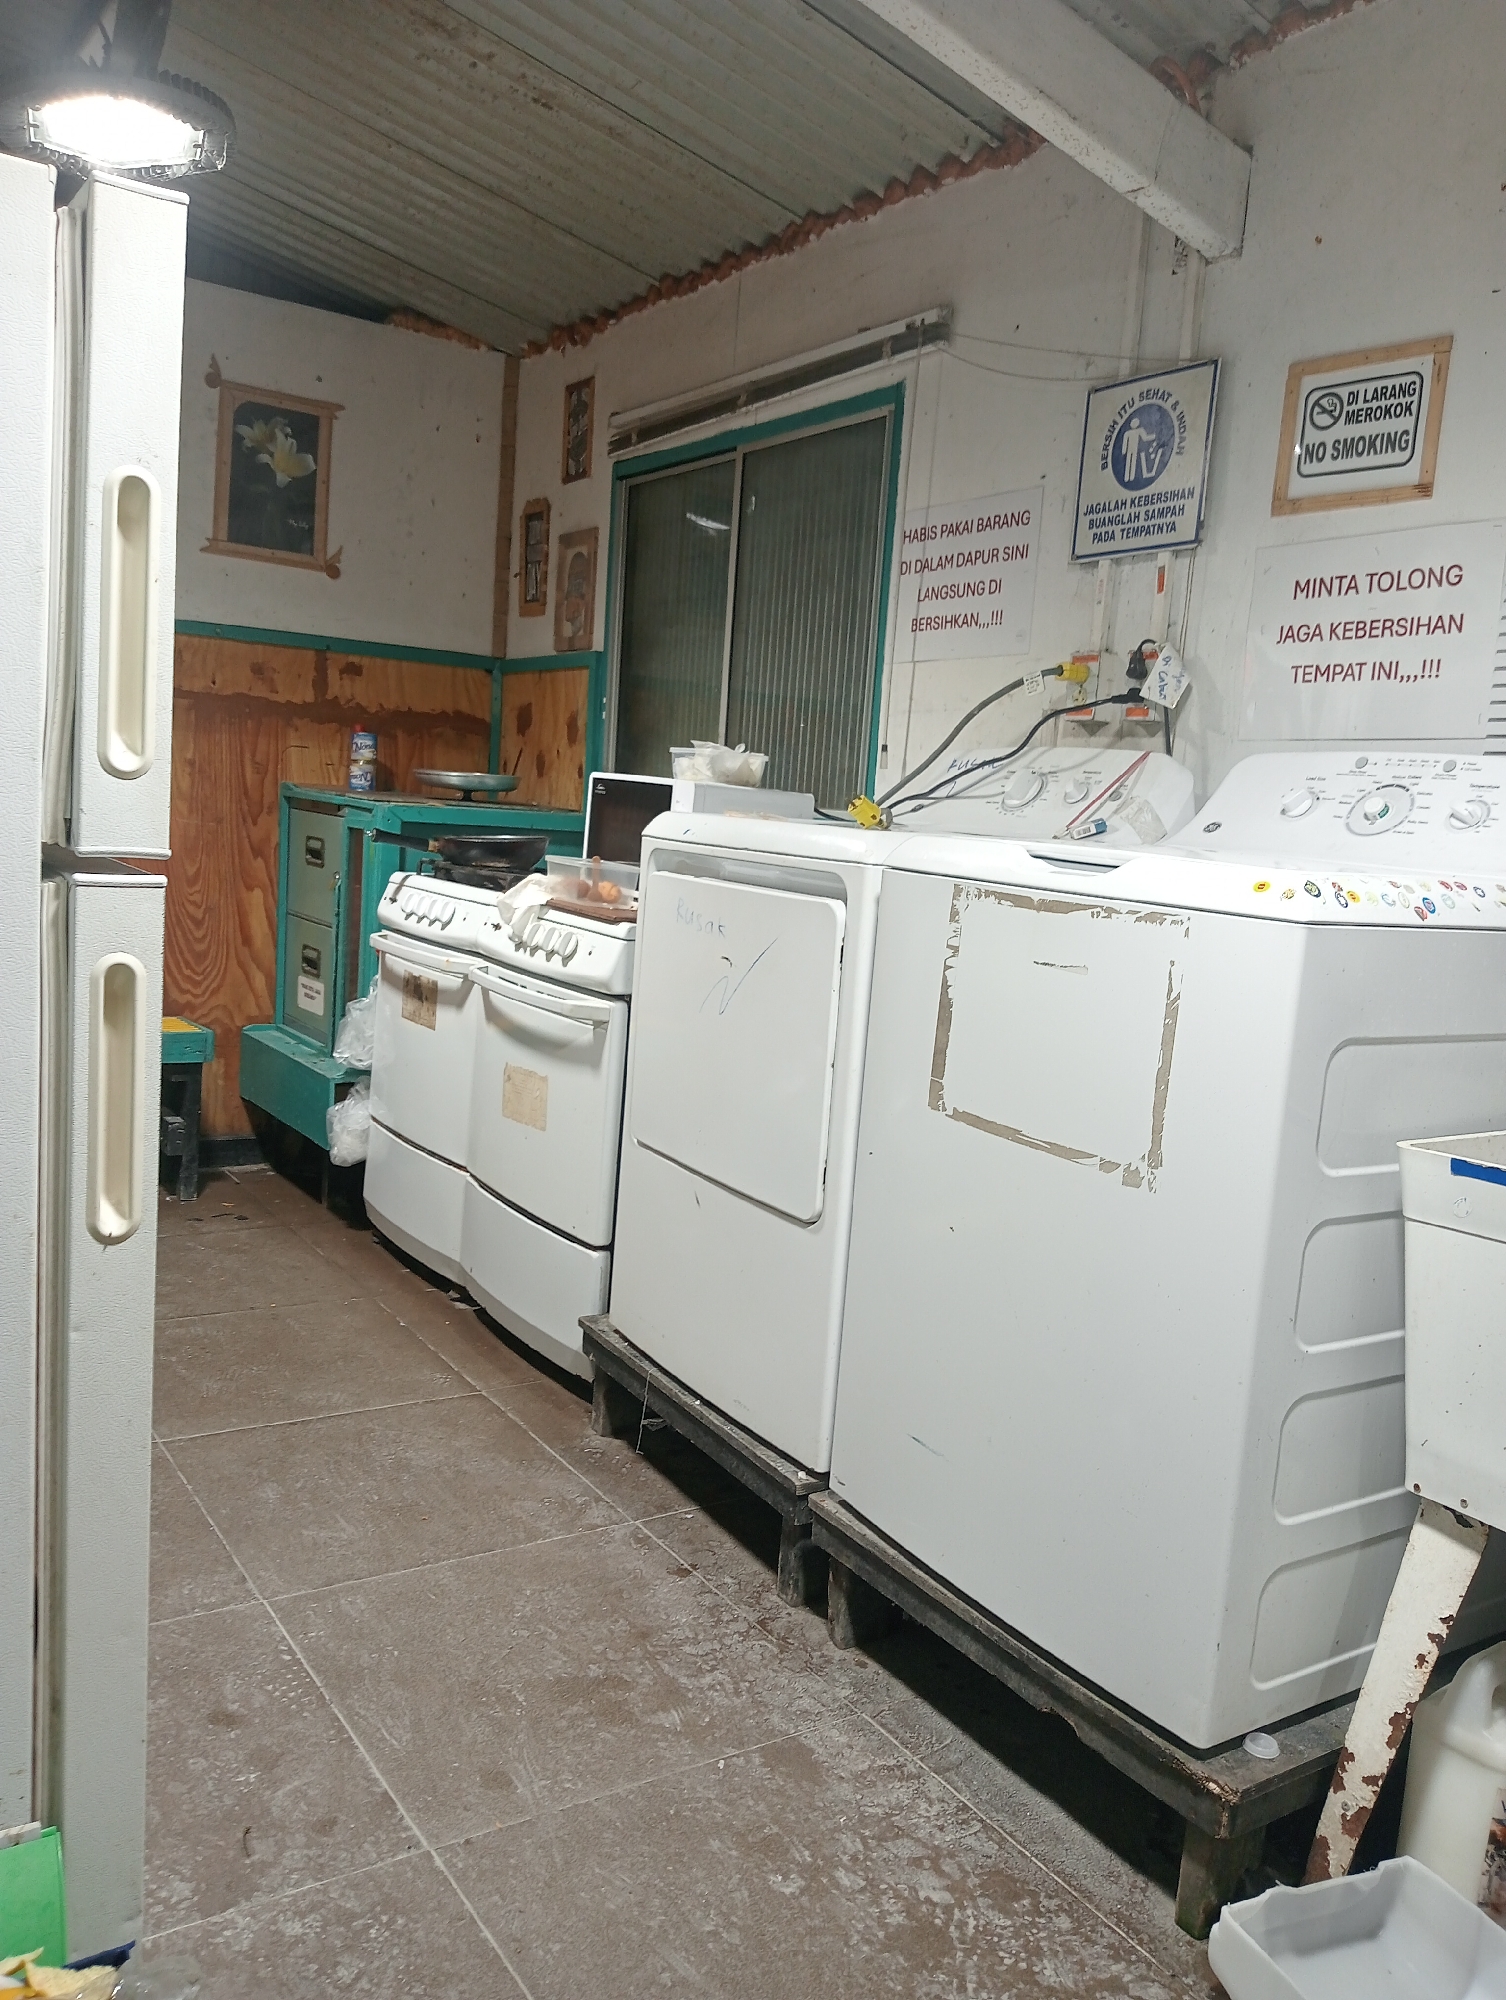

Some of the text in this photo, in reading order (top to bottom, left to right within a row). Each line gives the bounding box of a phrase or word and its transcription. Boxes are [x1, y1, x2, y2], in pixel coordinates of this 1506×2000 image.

[1346, 380, 1417, 407] DI LARANG
[1343, 400, 1415, 427] MEROKOK
[1100, 388, 1188, 472] BERSIH ITU SEHAT & INDAH
[1303, 429, 1411, 465] NO SMOKING
[1083, 486, 1196, 517] JAGALAH KEBERSIHAN
[903, 510, 1031, 545] HABIS PAKAI BARANG
[1088, 504, 1186, 531] BUANGLAH SAMPAH
[1092, 521, 1177, 545] PADA TEMPATNYA
[900, 543, 1029, 576] DI DALAM DAPUR SINI
[917, 578, 1002, 603] LANGSUNG DI
[1292, 564, 1464, 600] MINTA TOLONG
[1276, 613, 1465, 645] JAGA KEBERSIHAN
[1291, 661, 1367, 684] TEMPAT
